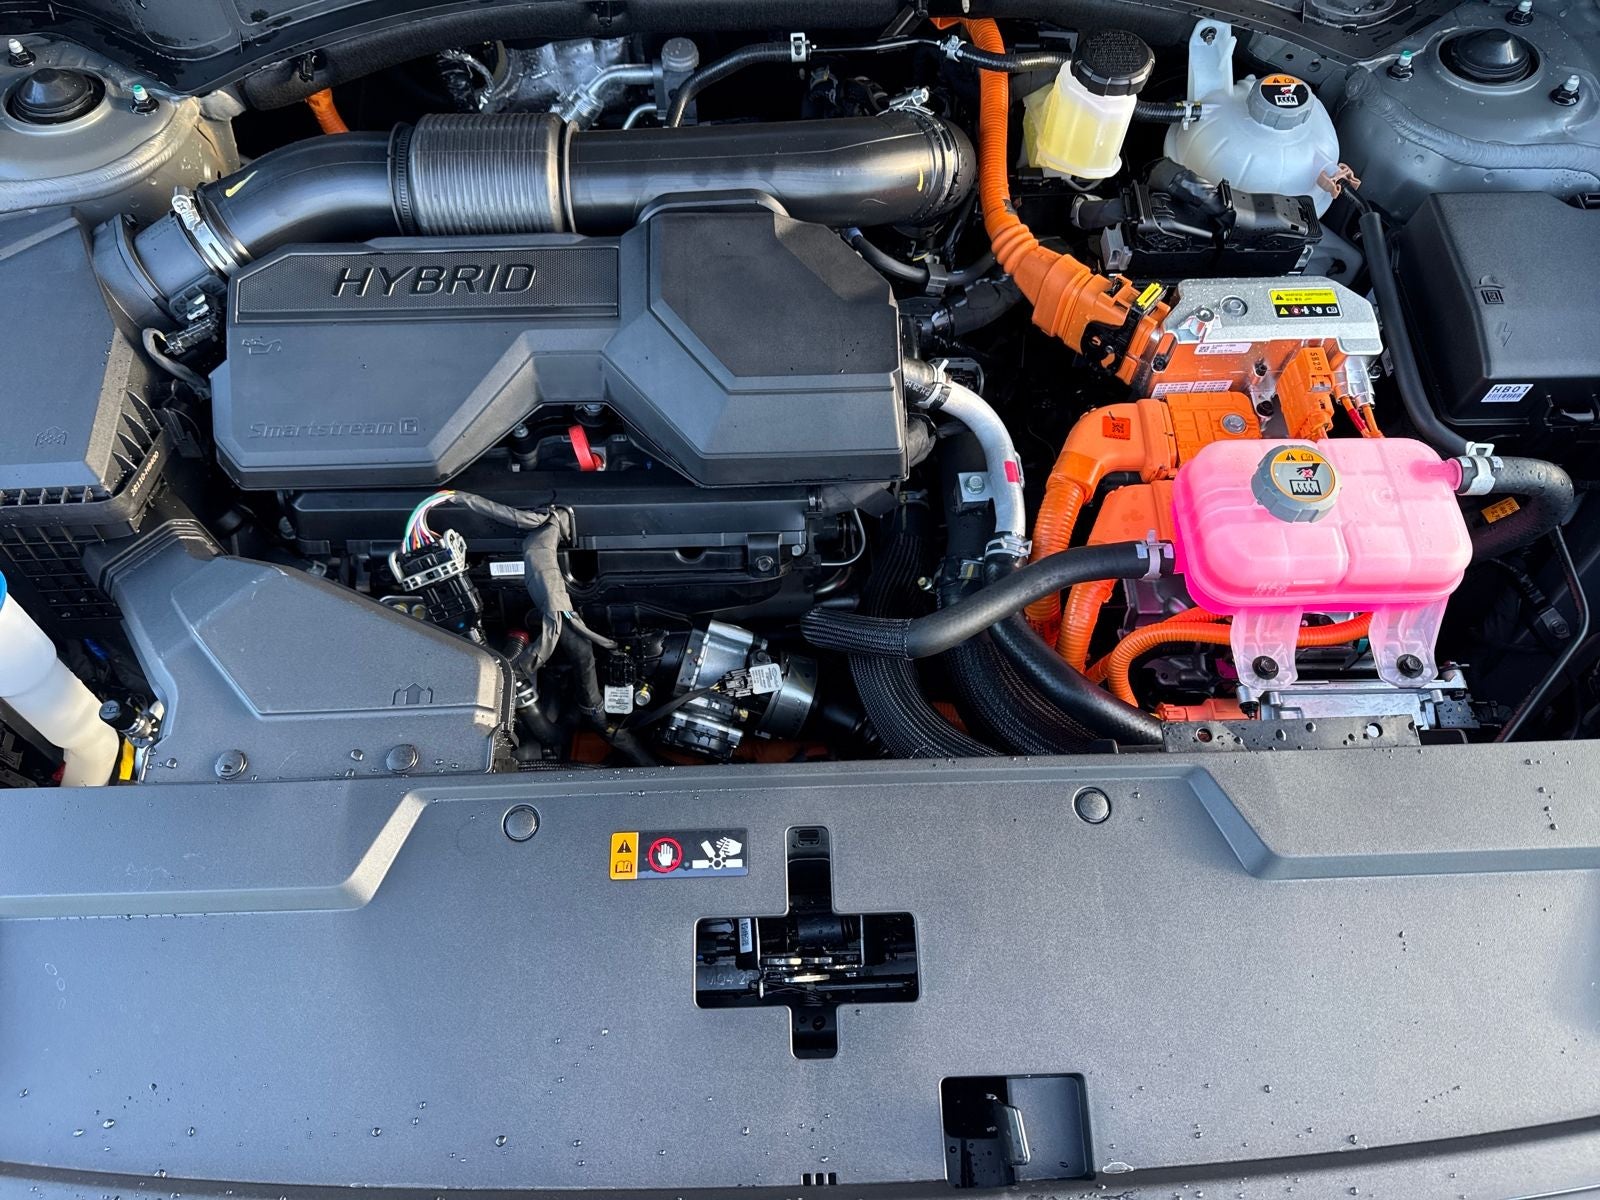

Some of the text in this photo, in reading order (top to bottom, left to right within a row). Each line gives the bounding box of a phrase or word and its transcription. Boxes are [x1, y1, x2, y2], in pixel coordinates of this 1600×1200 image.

[332, 263, 537, 297] HYBRID
[1491, 385, 1530, 393] HB01
[247, 420, 395, 439] Smartstream
